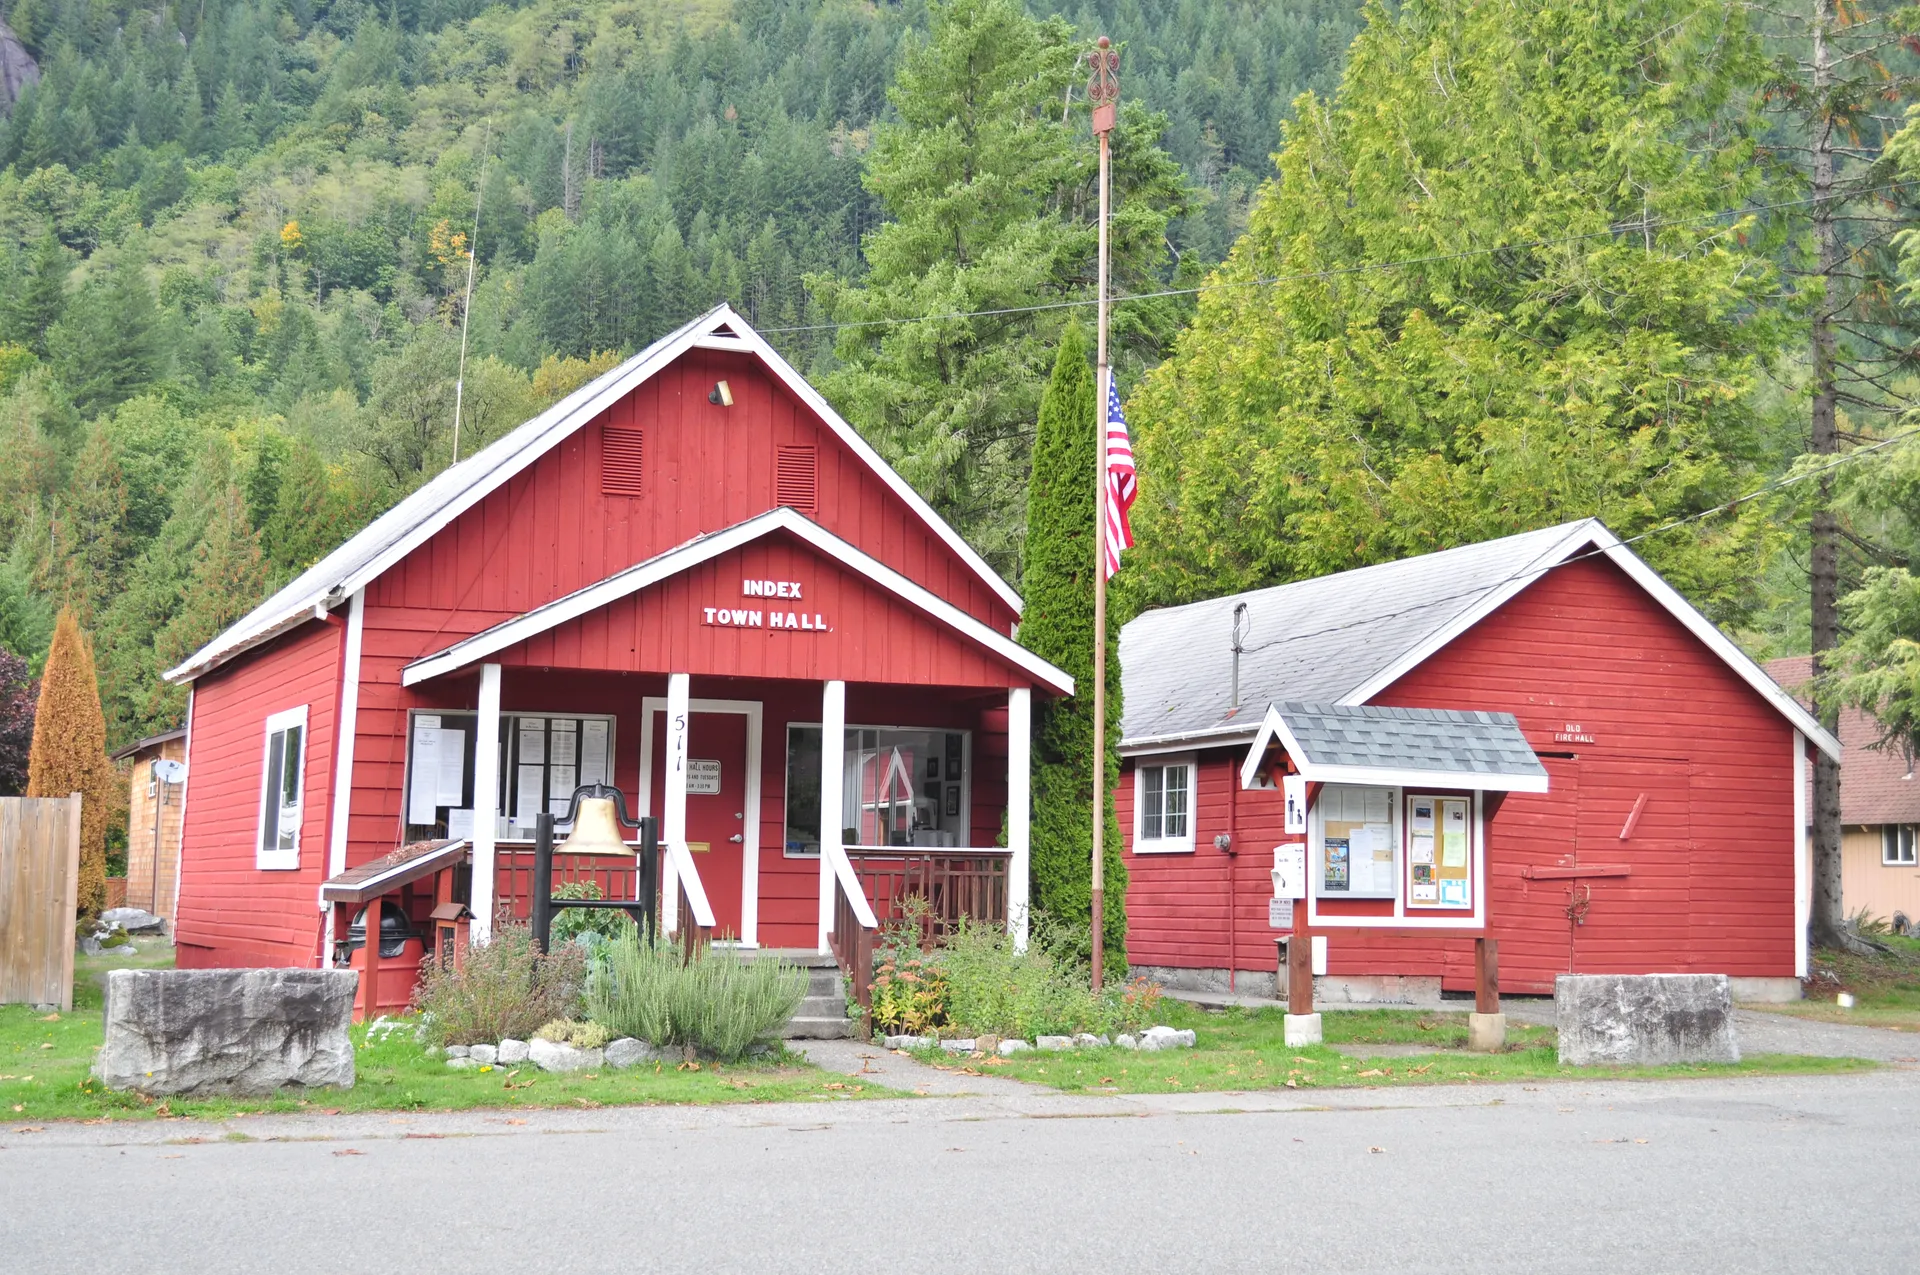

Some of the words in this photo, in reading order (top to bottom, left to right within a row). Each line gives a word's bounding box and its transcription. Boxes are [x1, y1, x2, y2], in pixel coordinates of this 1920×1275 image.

[743, 579, 802, 598] INDEX
[703, 607, 762, 627] TOWN
[769, 611, 827, 630] HALL
[1565, 724, 1580, 732] OLD
[675, 714, 685, 771] 511
[1555, 733, 1572, 741] FIRE
[1574, 733, 1594, 743] HALL
